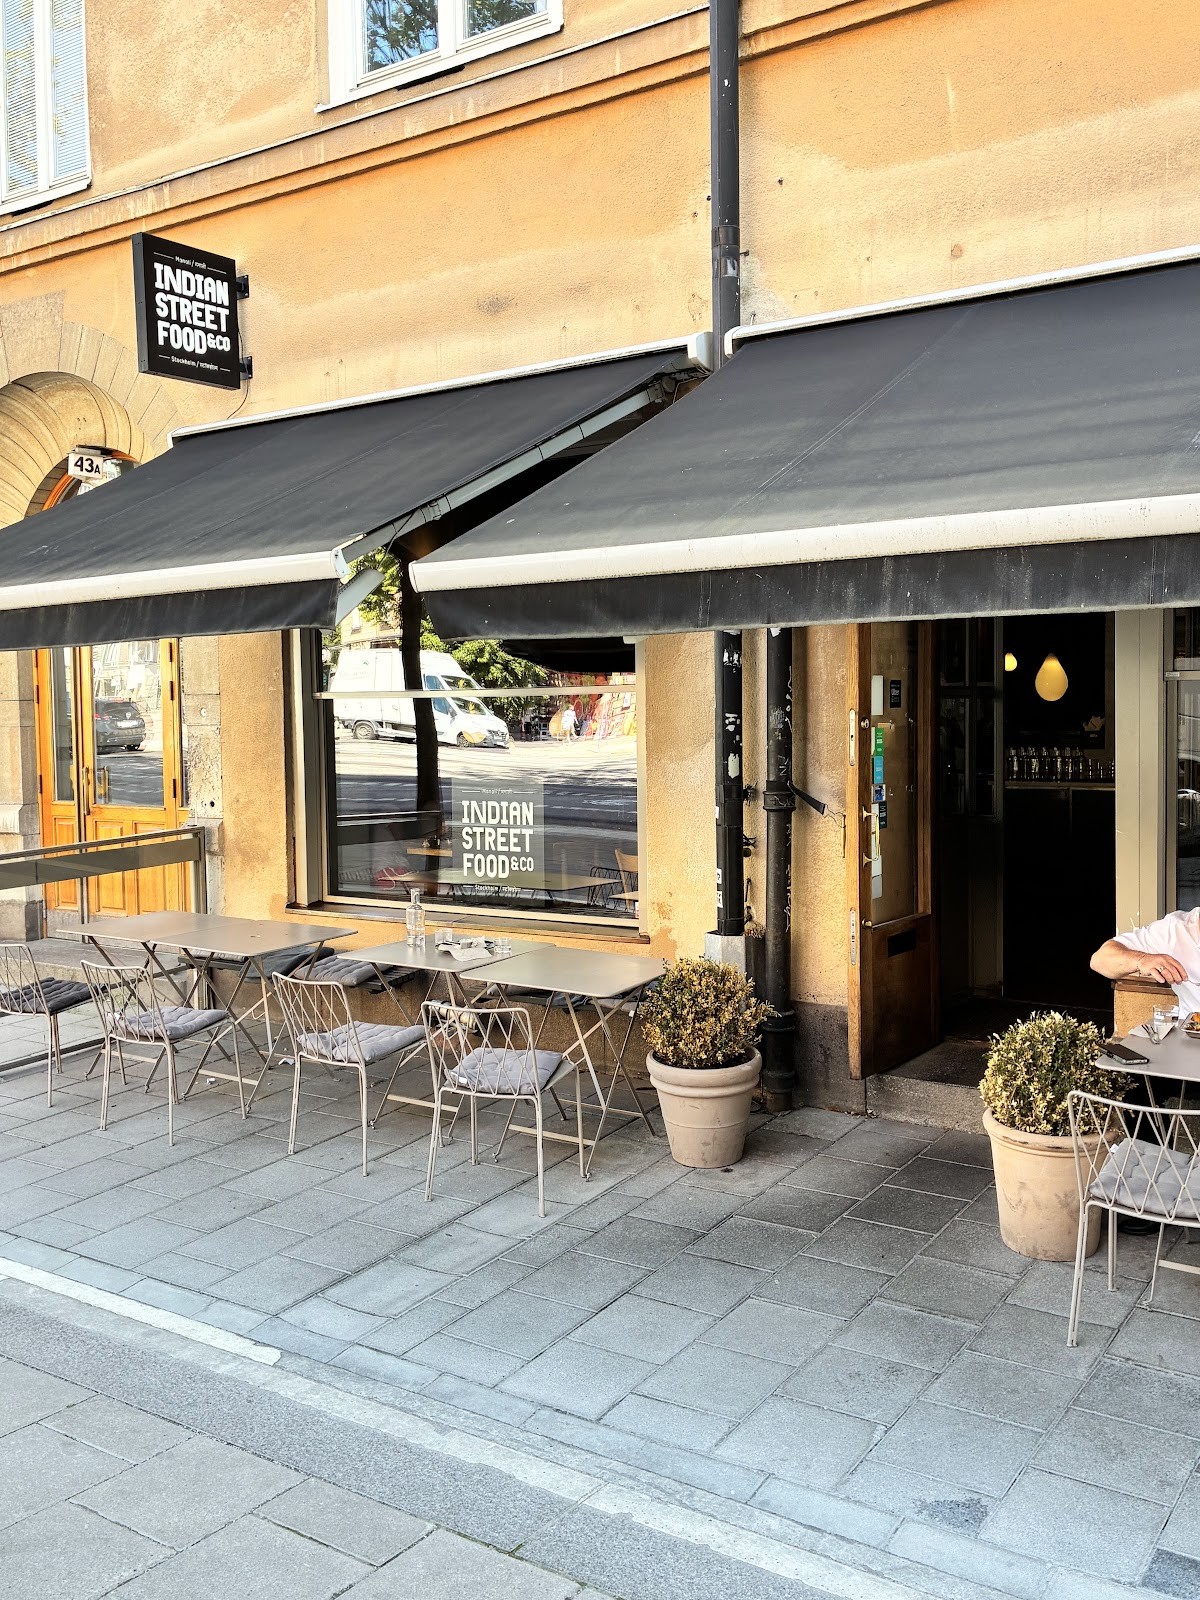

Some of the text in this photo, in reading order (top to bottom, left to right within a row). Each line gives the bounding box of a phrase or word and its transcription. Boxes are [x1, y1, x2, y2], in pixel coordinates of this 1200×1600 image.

[154, 262, 229, 306] INDIAN
[155, 292, 229, 332] STREET
[461, 800, 534, 826] INDIAN
[461, 826, 534, 853] STREET
